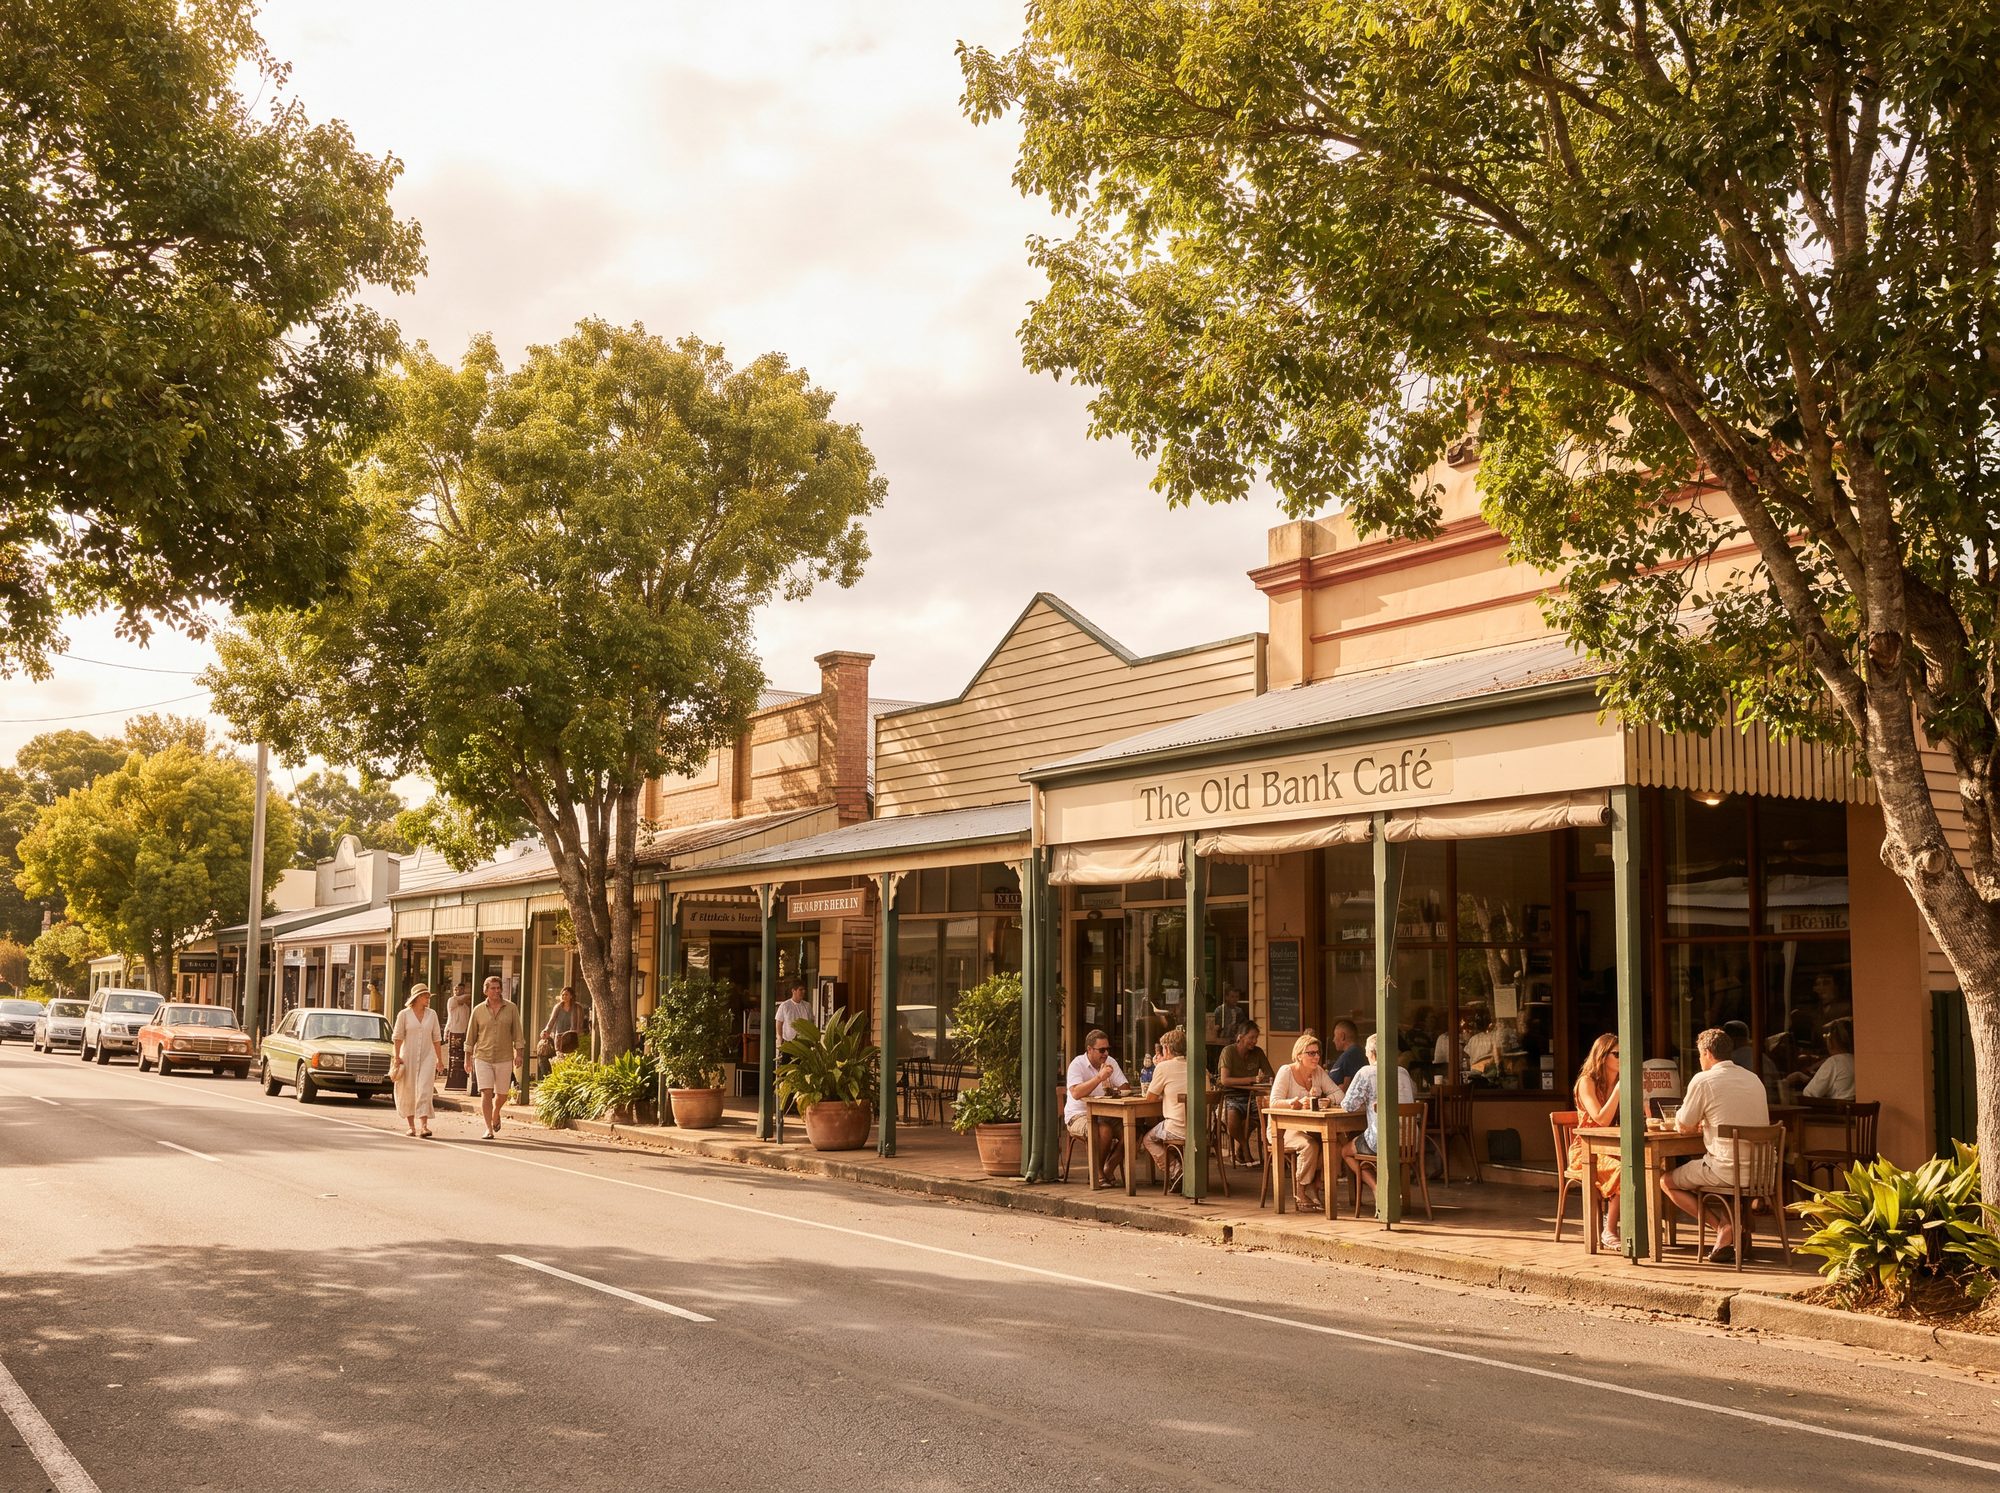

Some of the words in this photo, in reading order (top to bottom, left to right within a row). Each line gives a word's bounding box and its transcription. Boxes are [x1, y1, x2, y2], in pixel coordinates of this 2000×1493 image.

[1140, 785, 1191, 822] The
[1200, 773, 1250, 814] Old
[1261, 762, 1343, 808] Bank
[1353, 748, 1433, 796] Café
